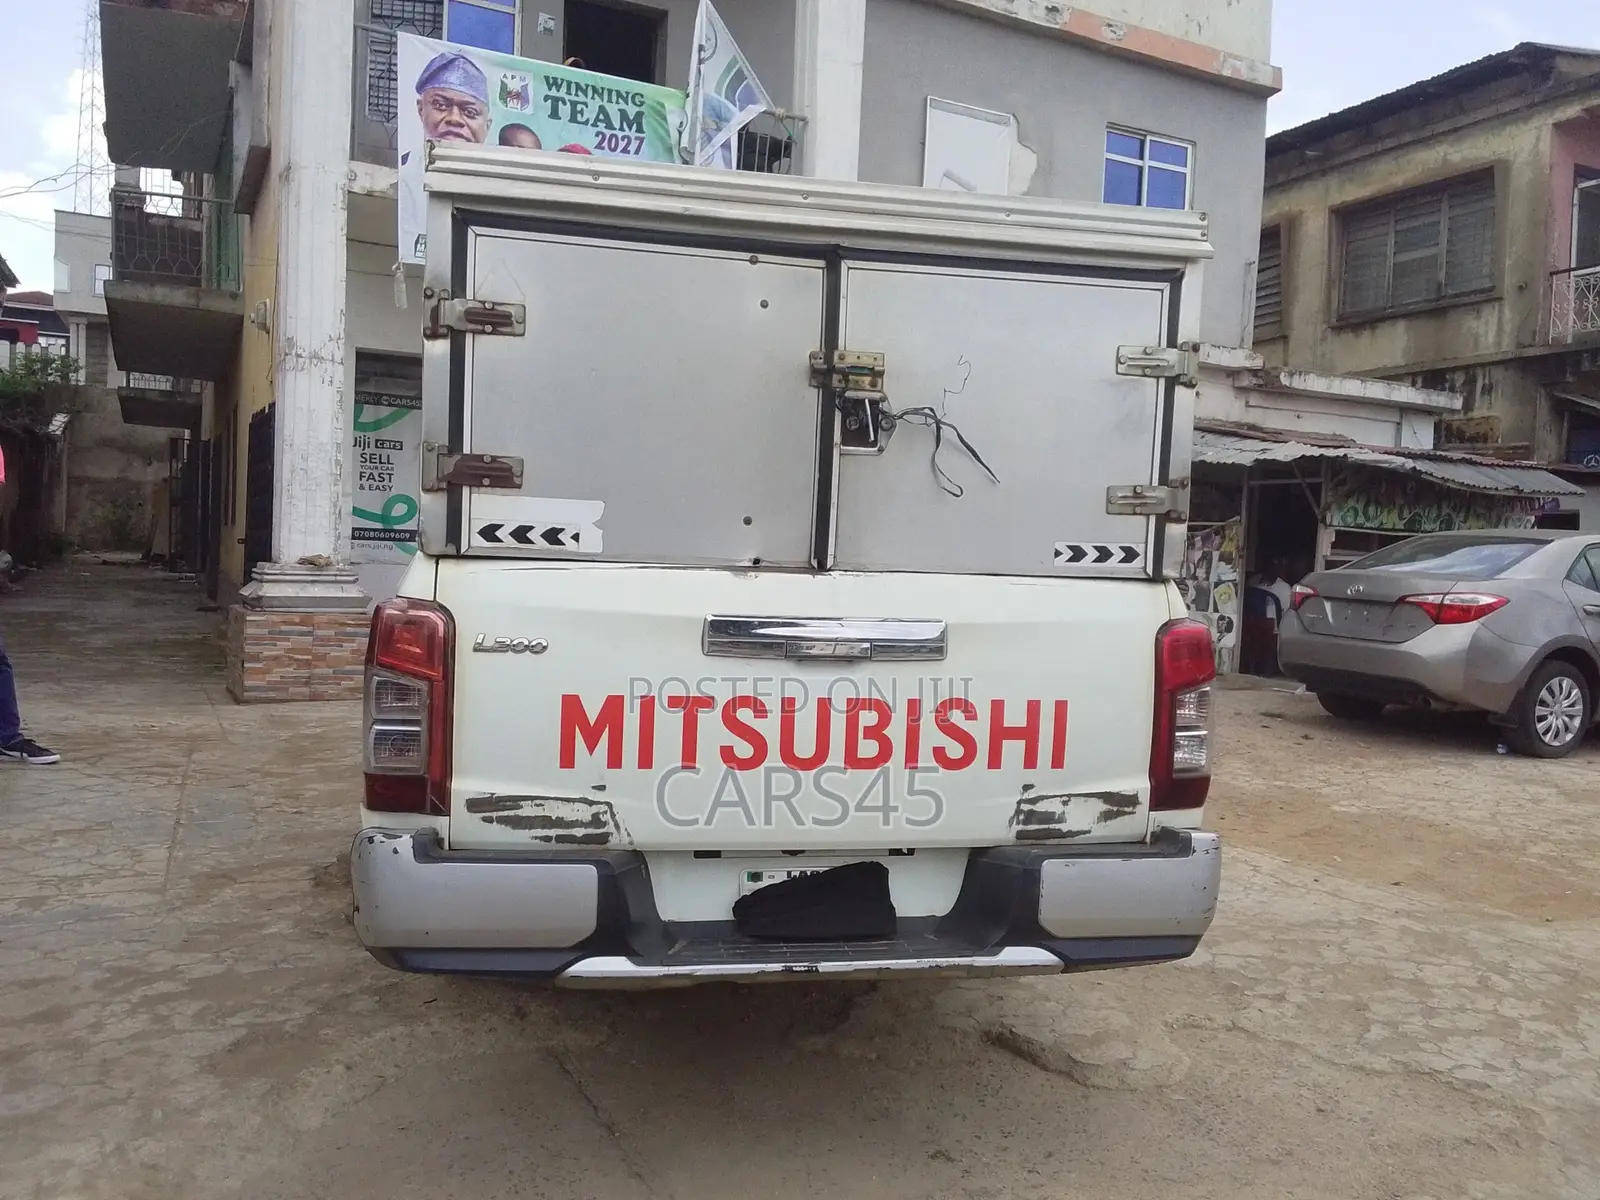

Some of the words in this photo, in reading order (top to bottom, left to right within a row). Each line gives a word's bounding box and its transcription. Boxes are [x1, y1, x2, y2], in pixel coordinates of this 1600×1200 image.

[543, 75, 646, 108] WINNING
[542, 94, 646, 134] TEAM
[593, 130, 646, 155] 2027
[377, 440, 402, 449] cars
[359, 452, 395, 466] SELL
[358, 470, 395, 483] FAST
[358, 483, 366, 491] &
[368, 483, 394, 492] EASY
[354, 530, 411, 539] 07080609609
[472, 632, 549, 655] L200
[559, 694, 1068, 771] MITSUBISHI
